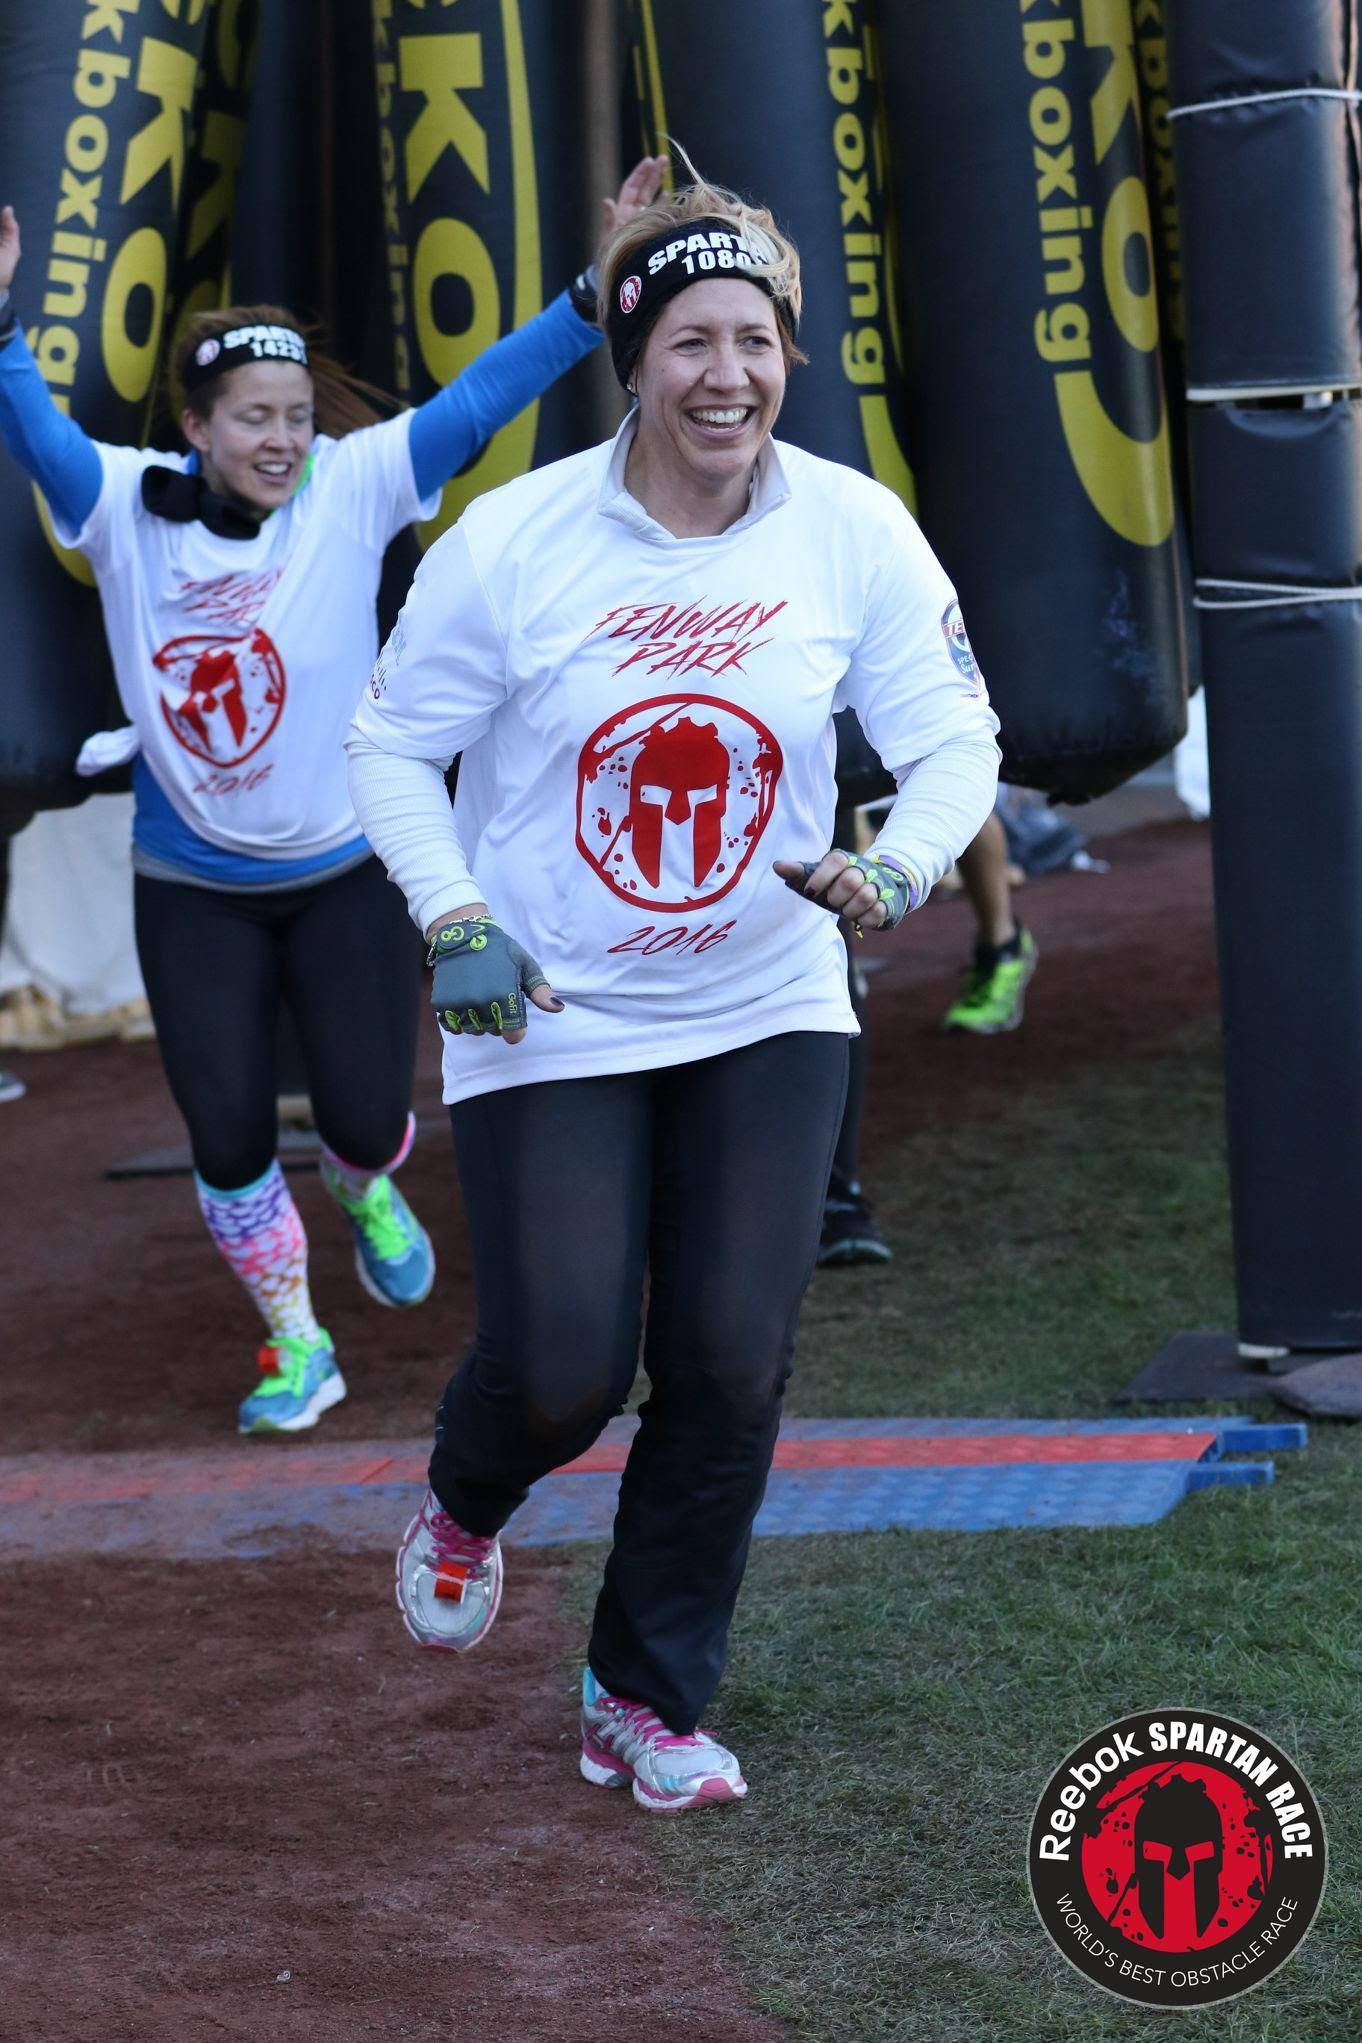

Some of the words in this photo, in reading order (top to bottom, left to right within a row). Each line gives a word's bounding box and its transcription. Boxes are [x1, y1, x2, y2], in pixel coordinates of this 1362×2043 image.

[1019, 0, 1093, 363] boxing
[648, 232, 768, 276] SPARTA
[581, 595, 788, 645] FENWAY
[611, 637, 774, 678] PARK
[607, 919, 738, 956] 2016
